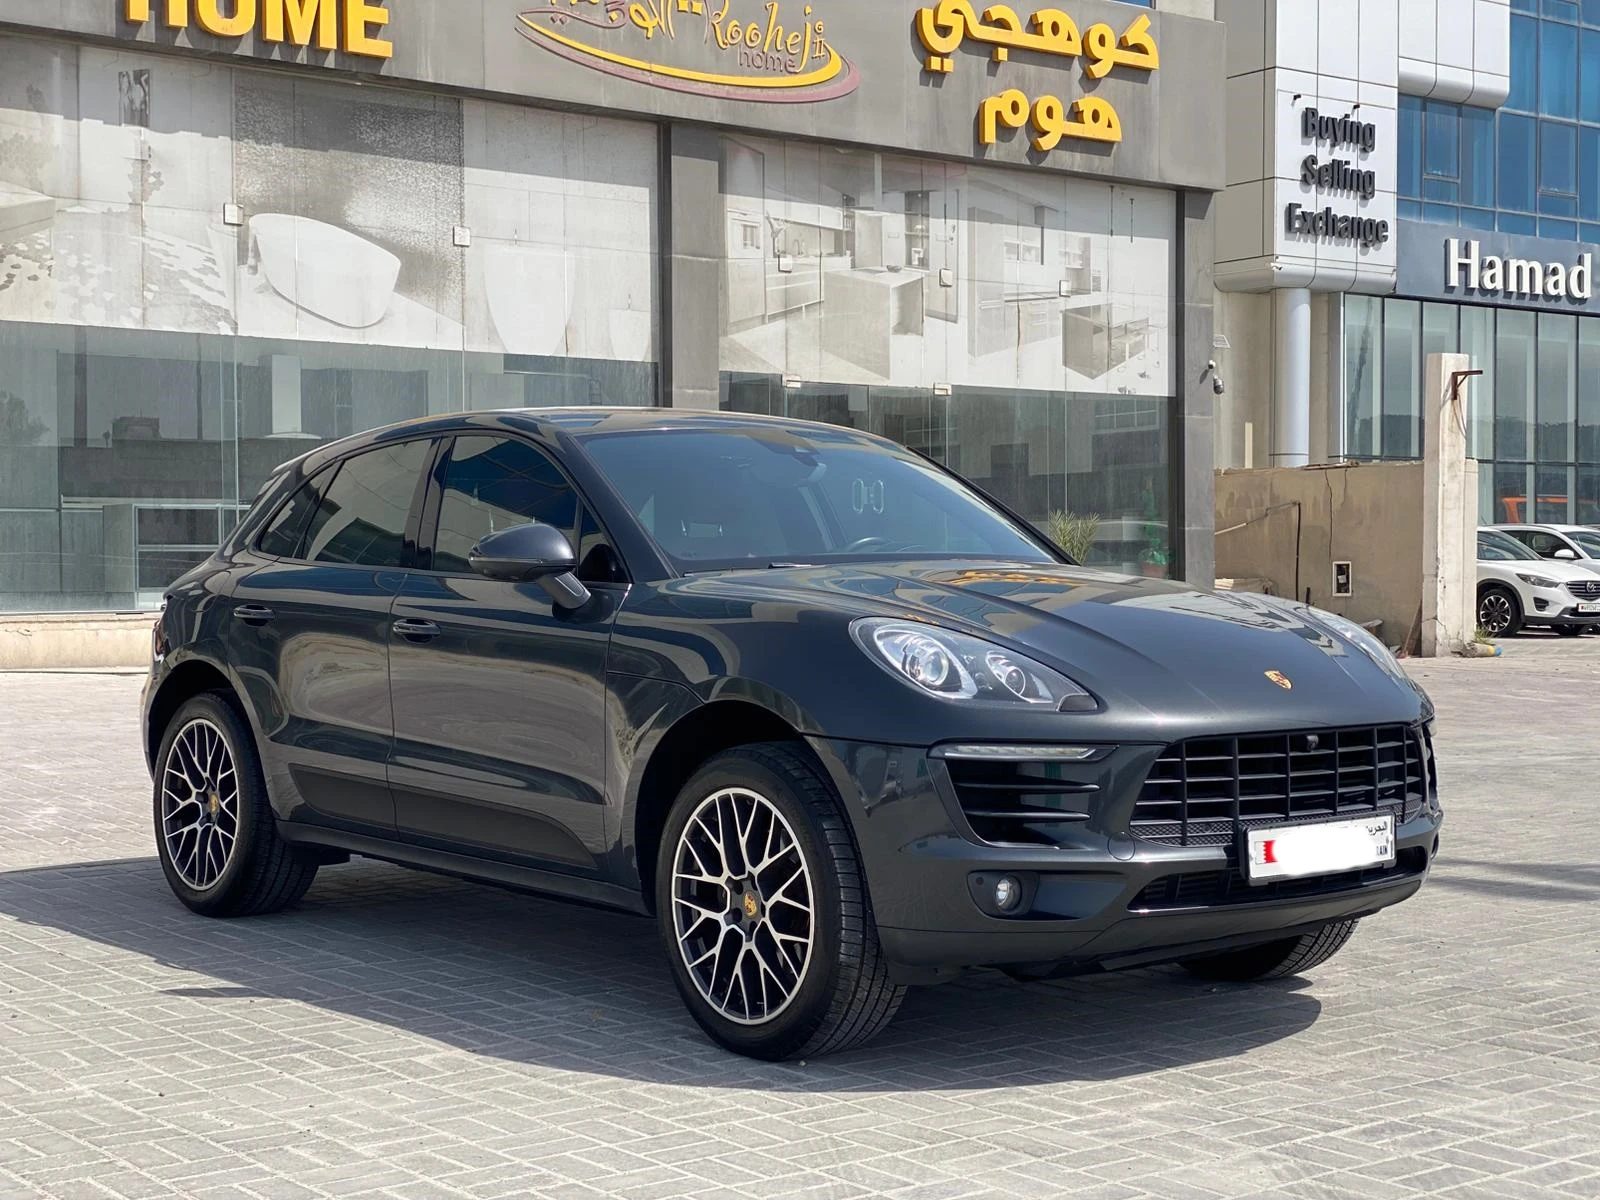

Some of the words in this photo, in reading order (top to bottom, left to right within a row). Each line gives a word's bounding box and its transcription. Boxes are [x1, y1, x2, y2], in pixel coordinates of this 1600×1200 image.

[737, 43, 798, 74] home
[916, 0, 1160, 79] كوهجي
[979, 88, 1122, 151] هوم
[1303, 107, 1376, 152] Buying
[1301, 154, 1376, 199] Selling
[1287, 203, 1389, 247] Exchange
[1445, 238, 1593, 299] Hamad
